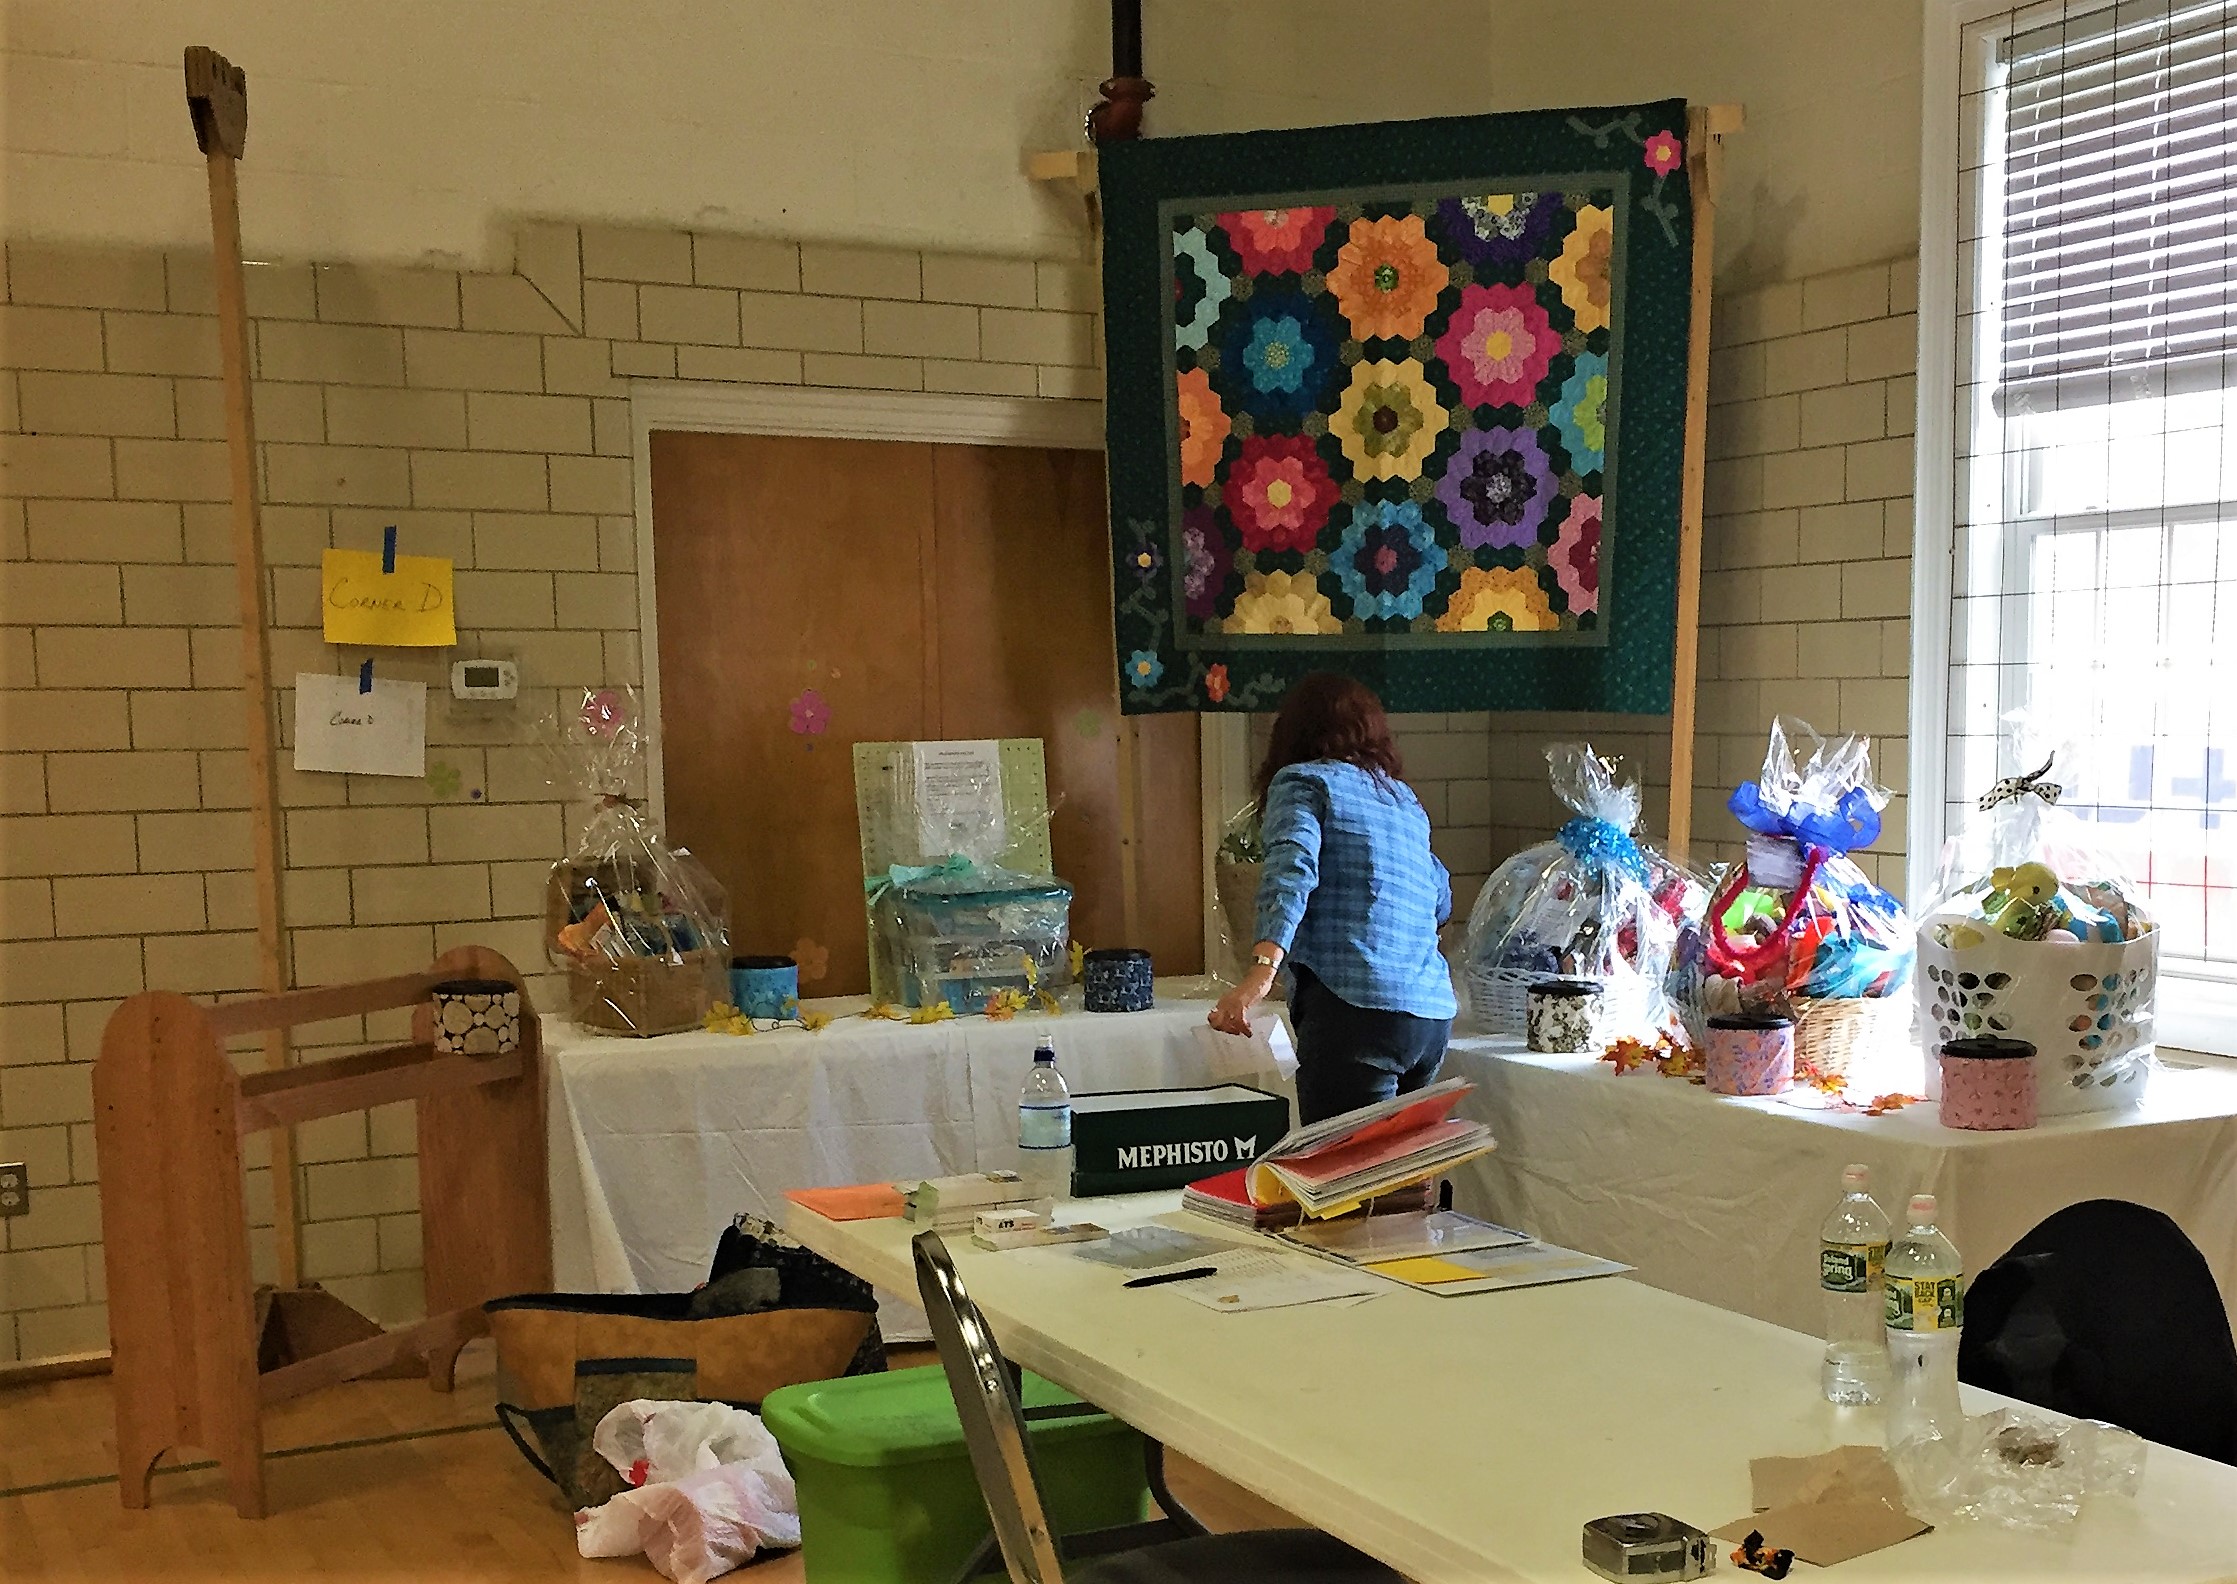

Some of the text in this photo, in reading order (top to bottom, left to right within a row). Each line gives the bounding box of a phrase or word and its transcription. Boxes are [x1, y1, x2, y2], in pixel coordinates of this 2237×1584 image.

[417, 582, 443, 613] D
[1117, 1134, 1257, 1170] MEPHISTO M
